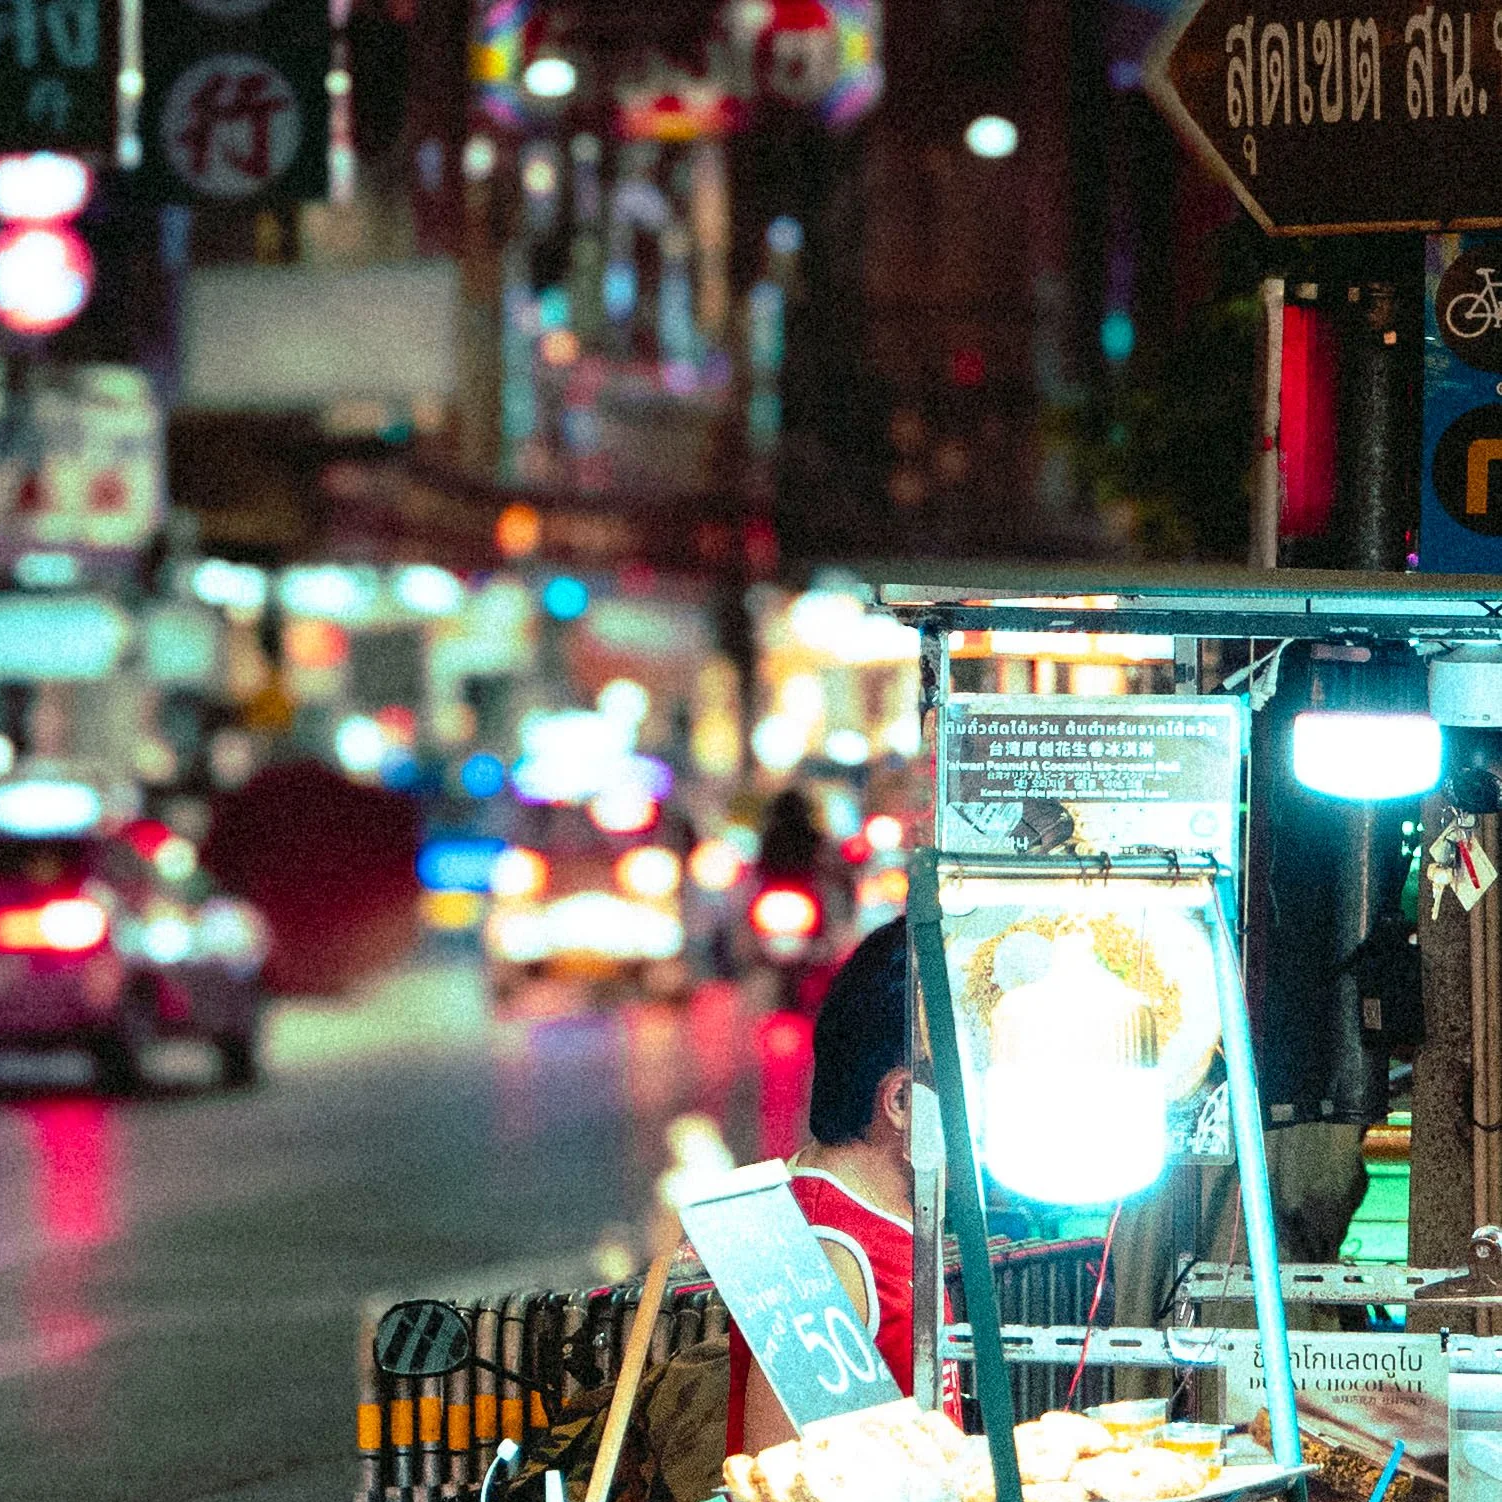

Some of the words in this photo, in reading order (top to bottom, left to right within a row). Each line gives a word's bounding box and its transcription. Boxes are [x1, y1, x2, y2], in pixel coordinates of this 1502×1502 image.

[1226, 15, 1381, 176] สุดเขต
[1404, 5, 1502, 120] สน.
[986, 760, 1029, 772] Peanut
[1030, 760, 1040, 771] &
[1041, 760, 1092, 772] Coconut
[1253, 1343, 1423, 1378] ช็กโกแลตดูไบ
[1249, 1377, 1307, 1391] DAI
[1315, 1378, 1428, 1393] CHOCOLATE
